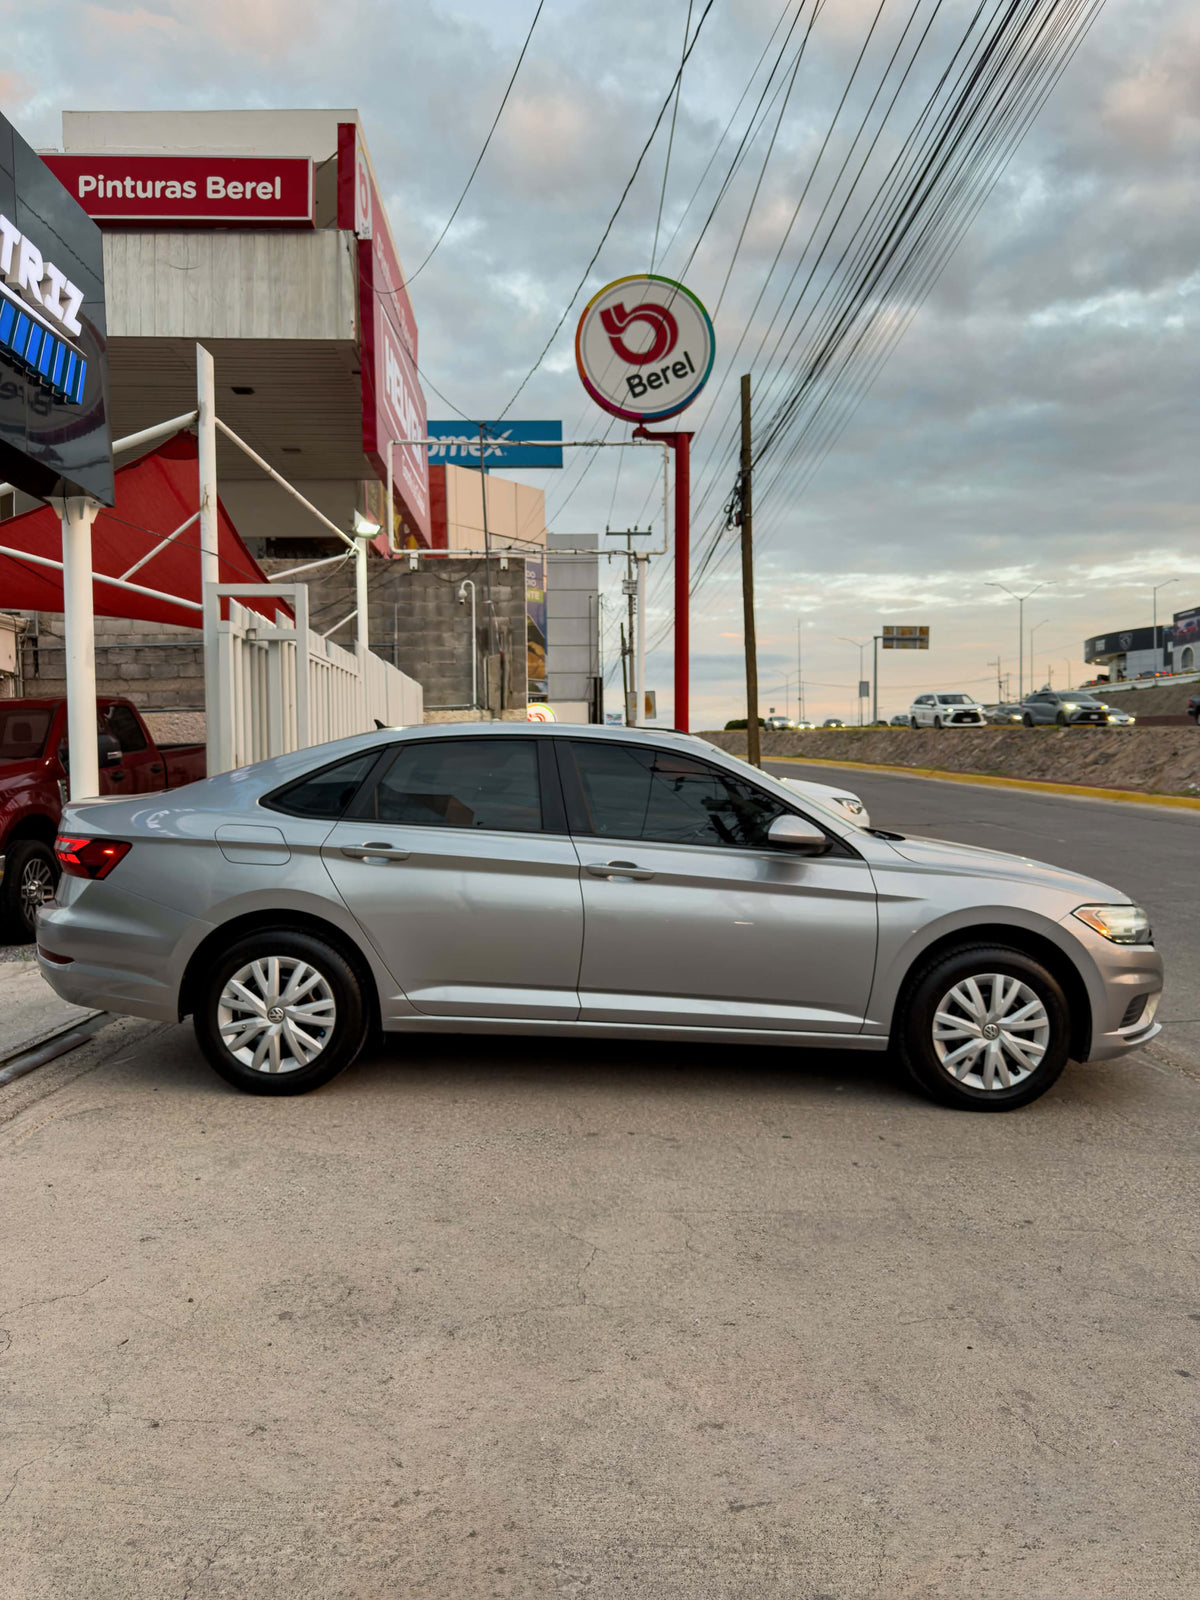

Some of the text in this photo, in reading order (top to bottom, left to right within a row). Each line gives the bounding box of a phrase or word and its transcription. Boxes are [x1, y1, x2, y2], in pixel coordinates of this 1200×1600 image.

[78, 174, 282, 200] Pinturas Berel
[626, 351, 695, 398] Berel
[427, 429, 513, 457] omex
